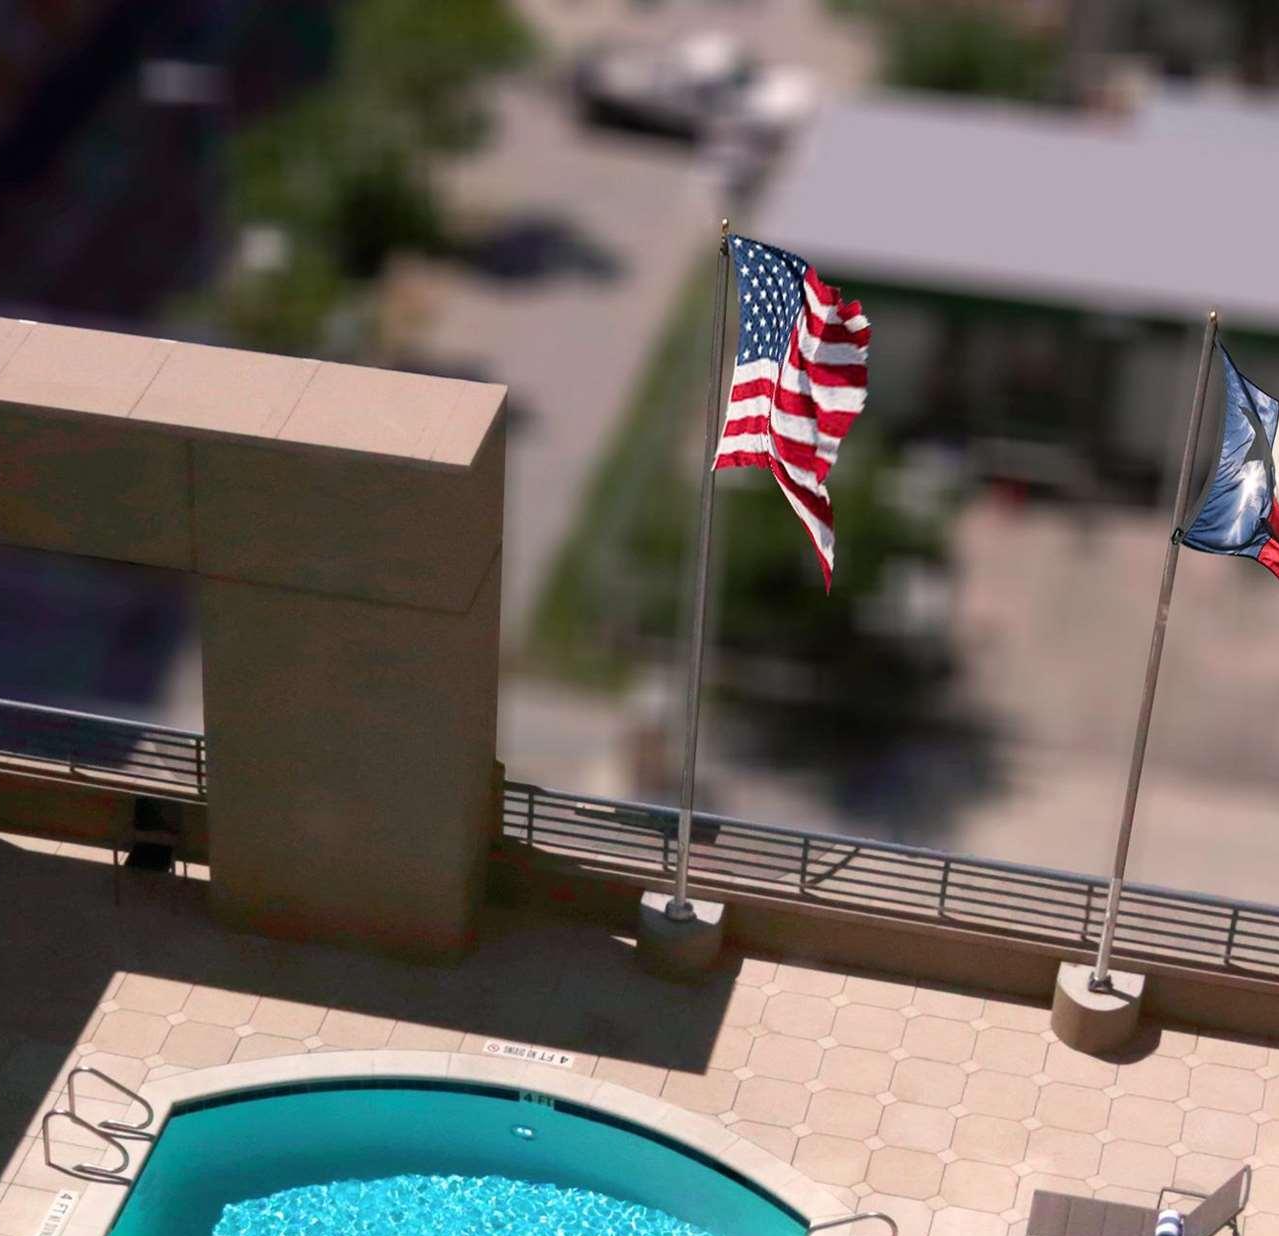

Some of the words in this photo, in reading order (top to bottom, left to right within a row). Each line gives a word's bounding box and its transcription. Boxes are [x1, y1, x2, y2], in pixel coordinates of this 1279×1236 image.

[539, 1052, 555, 1063] FT
[560, 1056, 569, 1064] 4
[52, 1203, 69, 1215] FT
